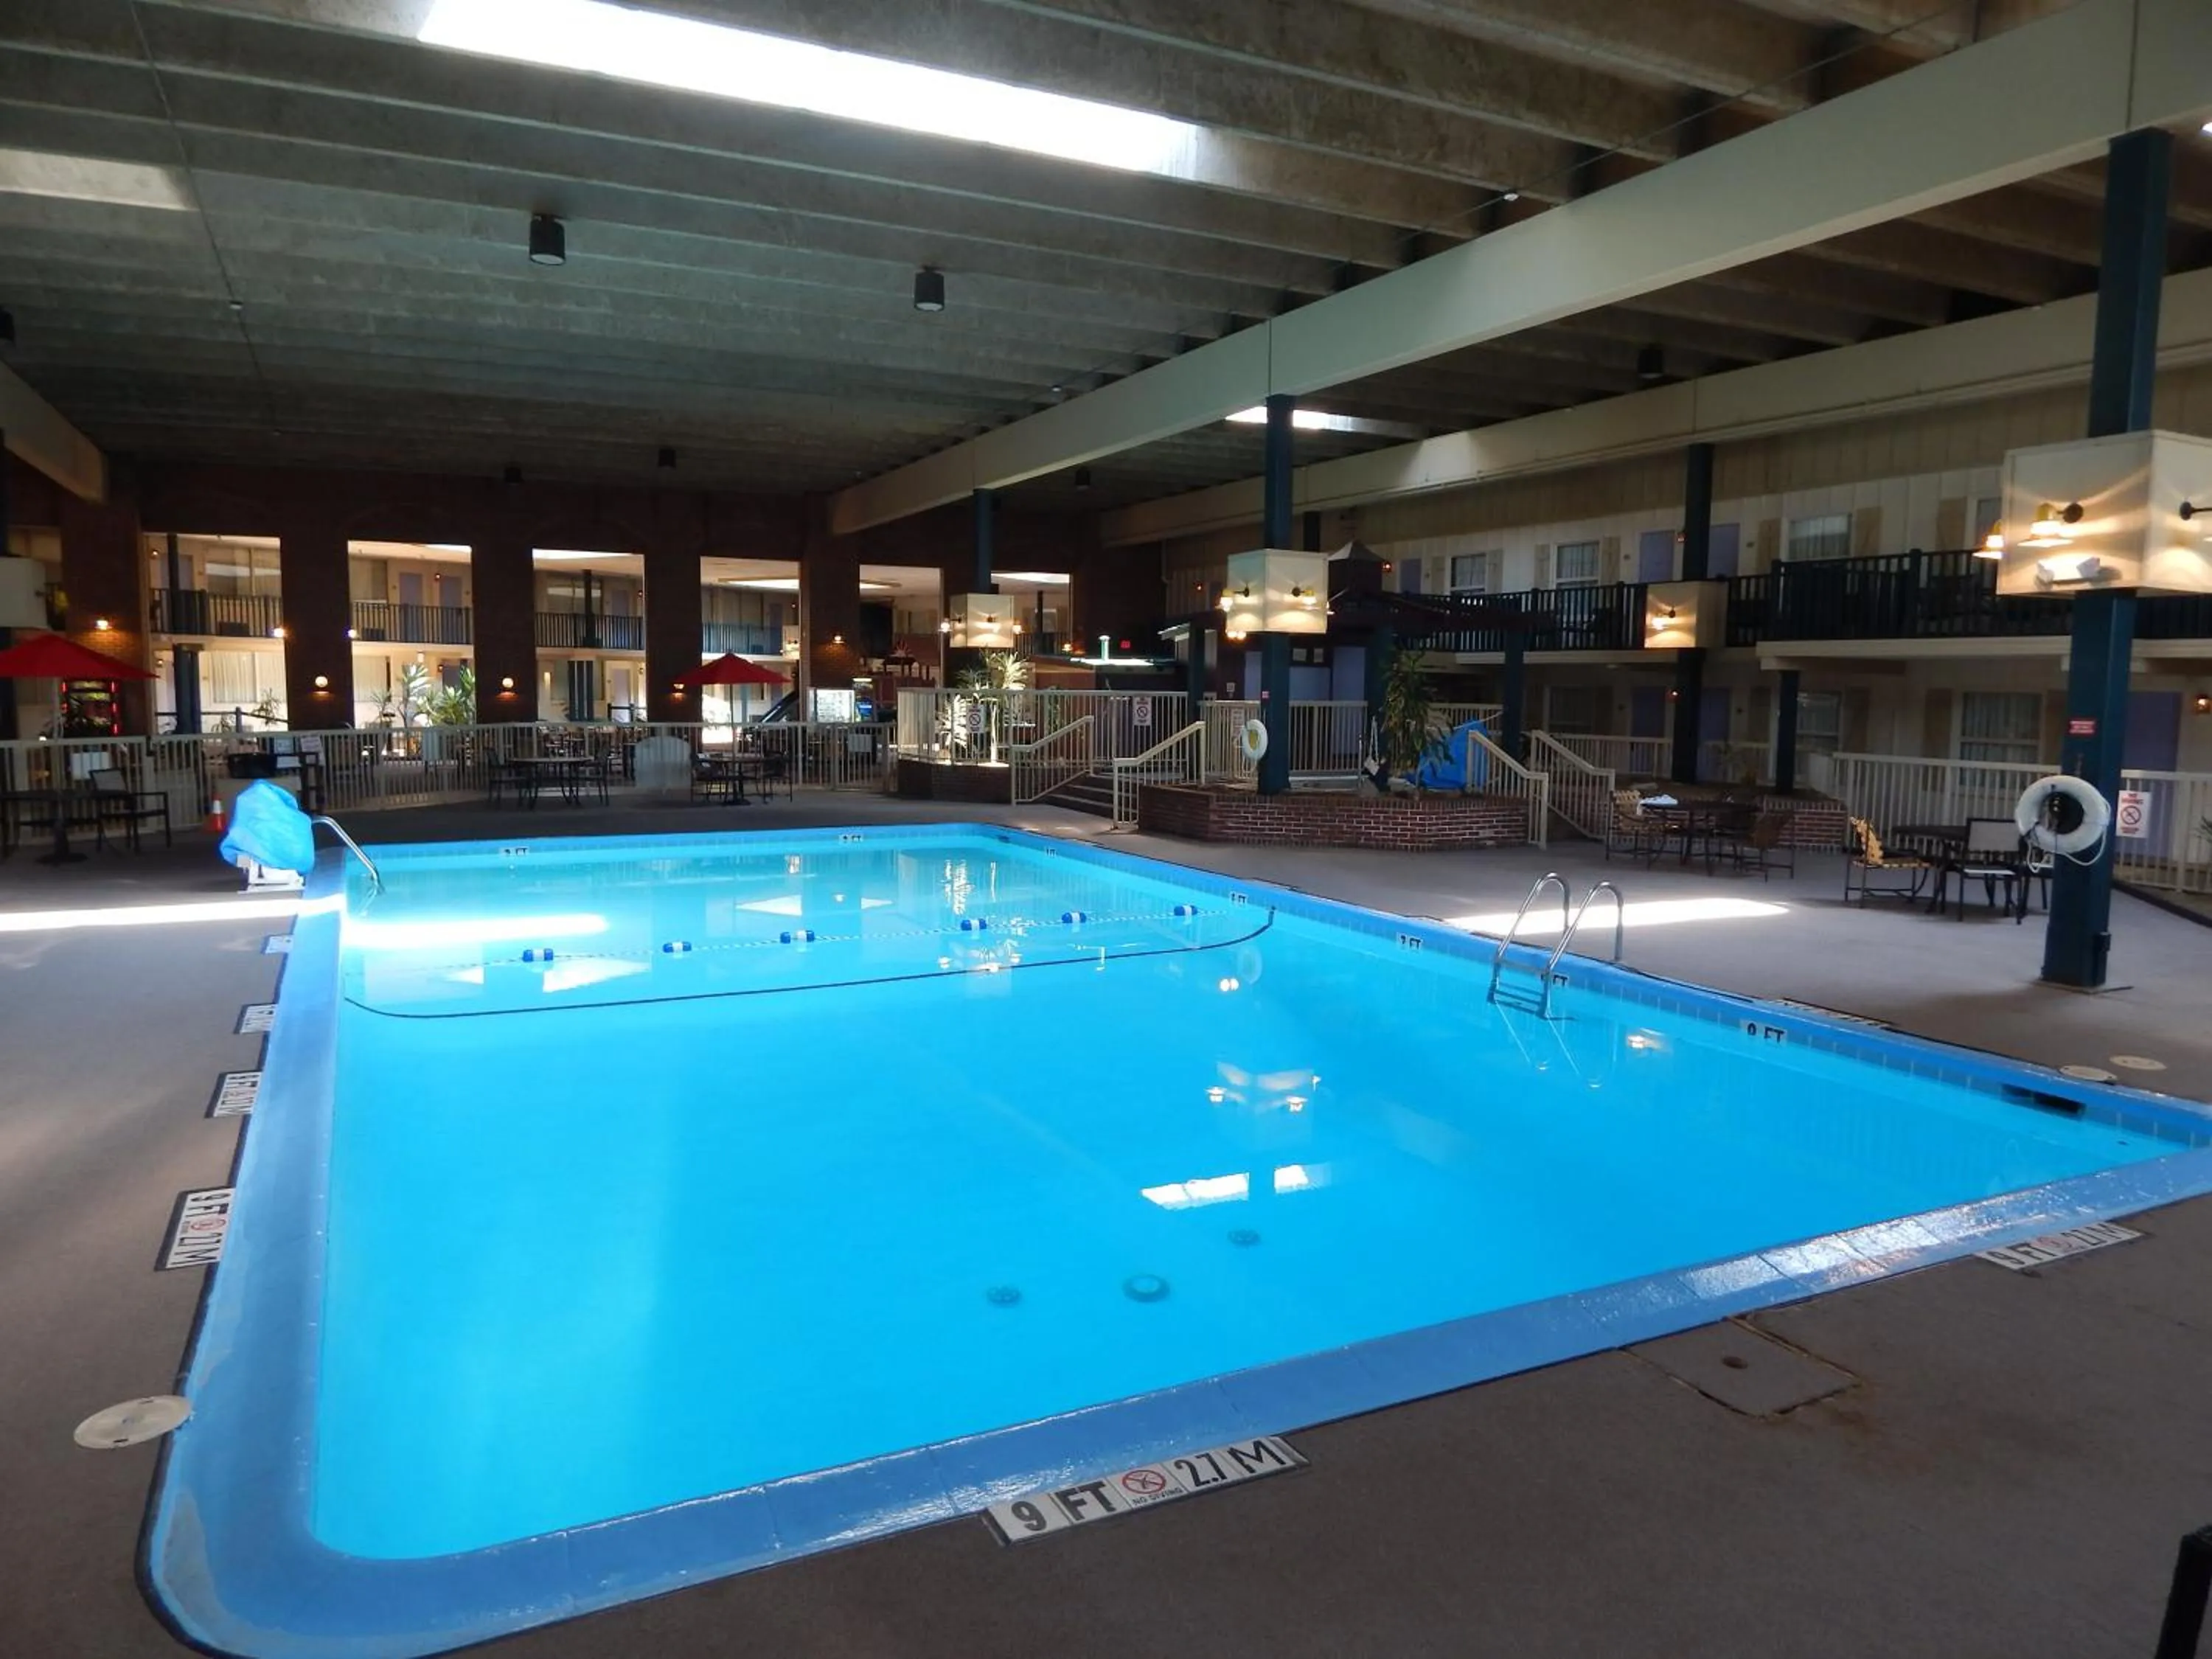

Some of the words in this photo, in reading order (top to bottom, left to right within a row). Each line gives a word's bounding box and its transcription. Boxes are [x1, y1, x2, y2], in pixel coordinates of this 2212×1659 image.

[1986, 1251, 2025, 1265] 9
[2006, 1242, 2056, 1261] FT
[1011, 1500, 1047, 1531] 9
[1054, 1480, 1116, 1521] FT
[1227, 1439, 1286, 1474] M
